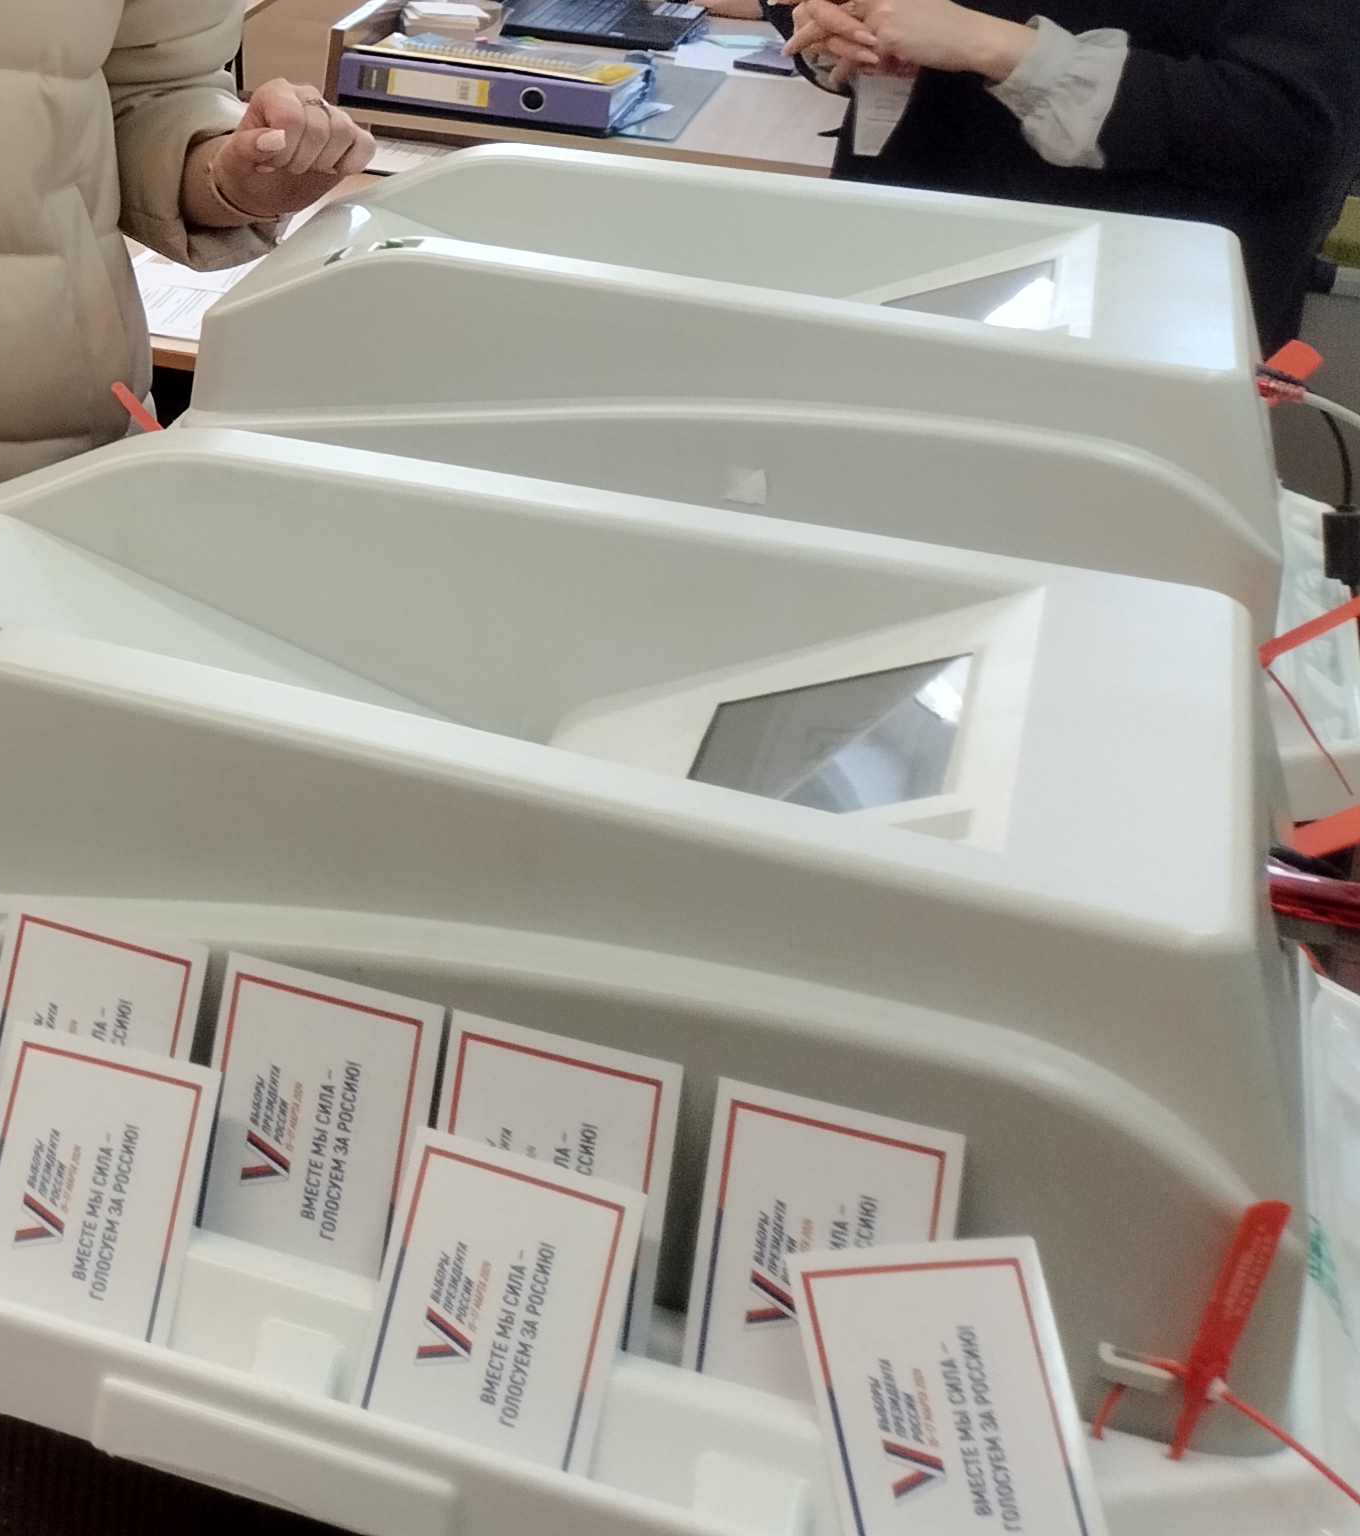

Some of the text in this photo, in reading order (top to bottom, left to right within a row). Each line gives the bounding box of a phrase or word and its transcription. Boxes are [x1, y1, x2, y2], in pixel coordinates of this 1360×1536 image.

[249, 1074, 265, 1127] ВЫБОРЫ
[261, 1064, 282, 1137] ПРЕЗИДЕНТА
[273, 1097, 289, 1145] РОССИИ
[316, 1084, 336, 1125] СИЛА
[92, 1146, 114, 1187] СИЛА
[310, 1126, 329, 1158] МЫ
[319, 1060, 363, 1242] ГОЛОСУЕМ ЗА РОССИЮ!
[576, 1122, 599, 1177] ССИЮ!
[86, 1188, 105, 1219] МЫ
[89, 1123, 140, 1302] ГОЛОСУЕМ ЗА РОССИЮ!
[300, 1159, 324, 1221] ВМЕСТЕ
[71, 1219, 98, 1281] ВМЕСТЕ
[752, 1209, 770, 1267] ВЫБОРЫ
[767, 1199, 787, 1278] ПРЕЗИДЕНТА
[830, 1220, 849, 1250] ИЛА
[430, 1250, 451, 1305] ВЫБОРЫ
[442, 1240, 469, 1315] ПРЕЗИДЕНТА
[455, 1276, 475, 1325] РОССИИ
[502, 1263, 527, 1307] СИЛА
[495, 1308, 517, 1340] МЫ
[498, 1241, 557, 1429] ГОЛОСУЕМ ЗА РОССИЮ!
[480, 1340, 509, 1406] ВМЕСТЕ
[940, 1358, 967, 1406] СИЛА
[952, 1410, 976, 1442] МЫ
[956, 1325, 1022, 1533] ГОЛОСУЕМ ЗА РОССИЮ!
[960, 1446, 993, 1517] ВМЕСТЕ
